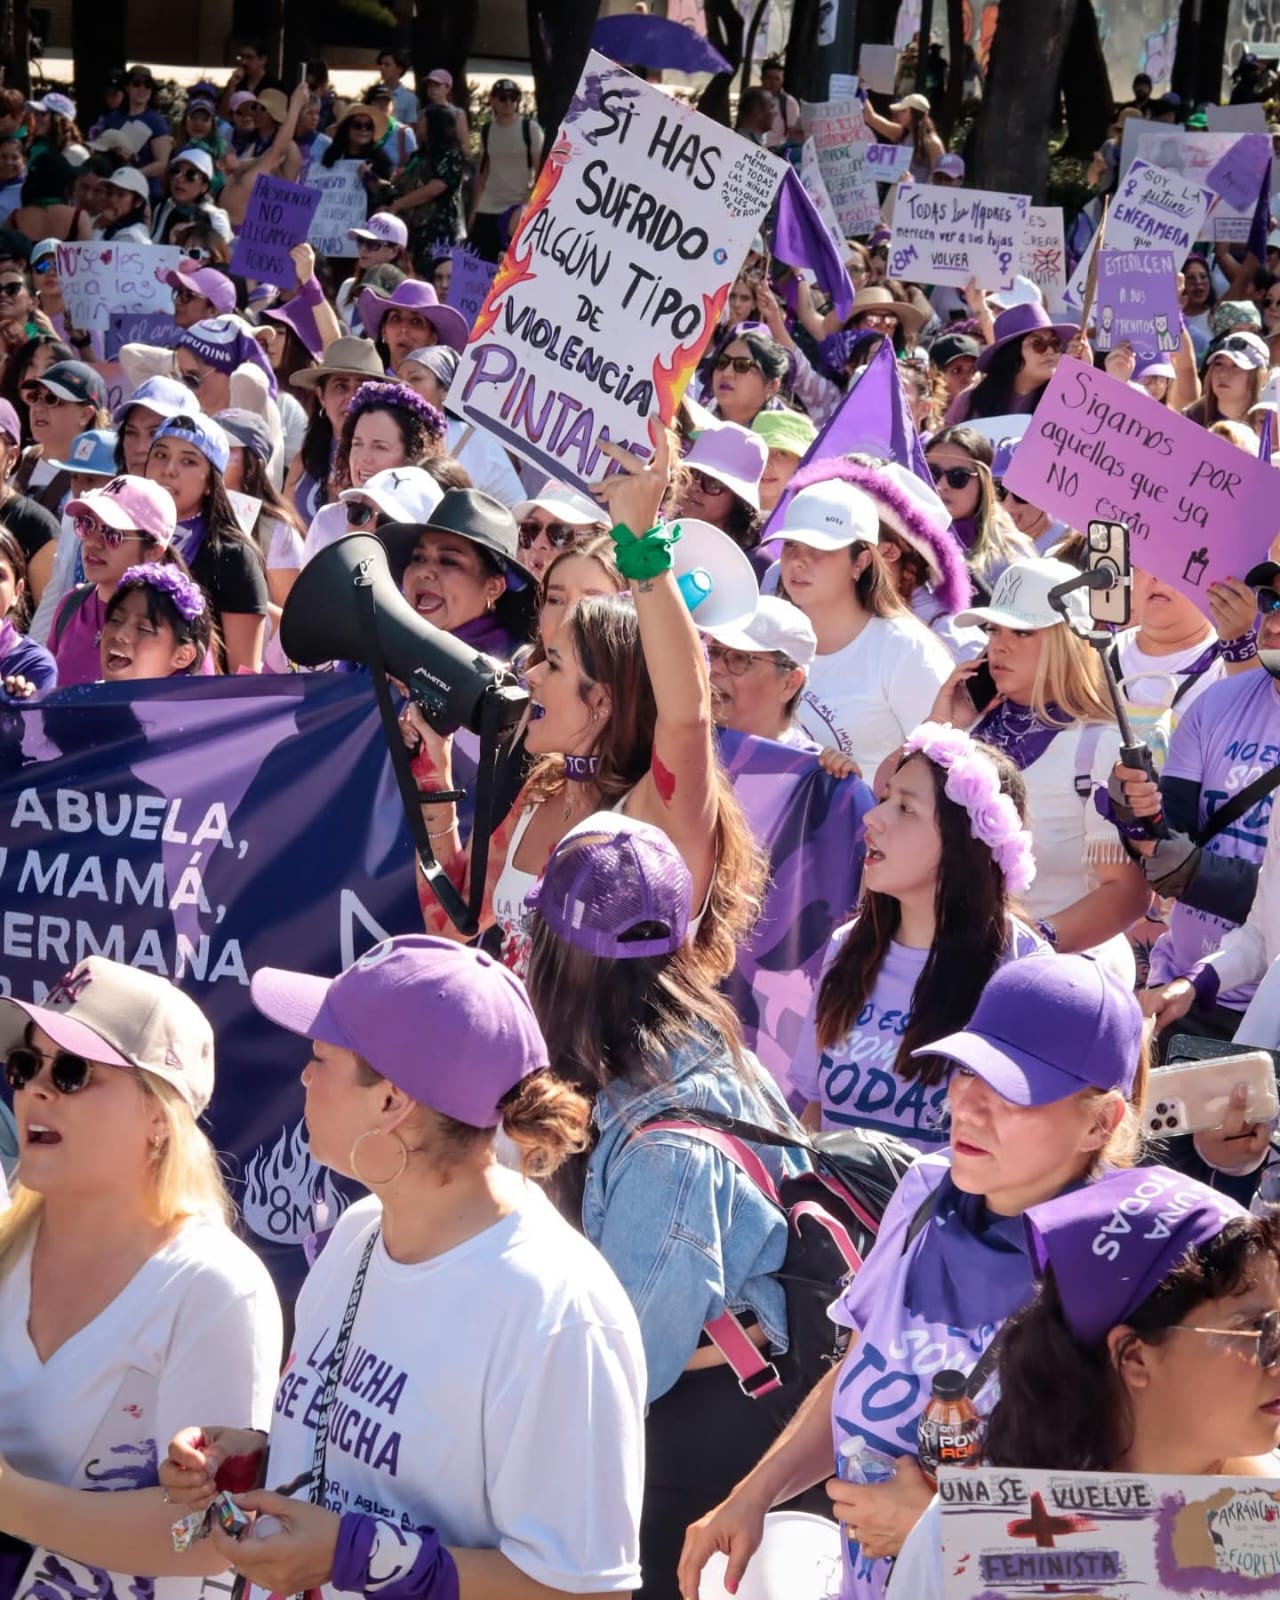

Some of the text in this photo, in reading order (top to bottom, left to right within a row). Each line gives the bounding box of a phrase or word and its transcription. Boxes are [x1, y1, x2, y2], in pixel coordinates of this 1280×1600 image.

[647, 115, 722, 191] HAS
[743, 153, 778, 180] MEMORIA
[755, 150, 767, 161] EN
[866, 143, 898, 166] 8M
[728, 170, 743, 183] LAS
[734, 160, 774, 188] DE TODAS
[1143, 169, 1171, 188] SOY
[260, 202, 283, 224] NO
[576, 159, 709, 261] SUFRIDO
[896, 226, 935, 240] merecen
[939, 230, 956, 243] ver
[967, 233, 984, 245] sus
[987, 229, 1014, 255] hijas
[1113, 203, 1190, 249] ENFERMERA
[523, 207, 612, 287] ALGÚN
[893, 243, 919, 270] 8M
[931, 251, 970, 267] VOLVER
[1119, 287, 1127, 304] A
[576, 293, 604, 332] DE
[1060, 371, 1242, 499] Sigamos POR
[1040, 421, 1209, 528] aquellas que ya
[1046, 462, 1079, 498] NO
[1224, 739, 1256, 763] NO
[11, 787, 249, 859] ABUELA,
[16, 850, 227, 925] MAMÁ,
[2, 910, 251, 987] ERMANA
[266, 1185, 316, 1236] 8M
[275, 1372, 308, 1420] SE
[940, 1478, 1151, 1508] UNA SE VUELVE
[984, 1551, 1117, 1580] FEMINISTA
